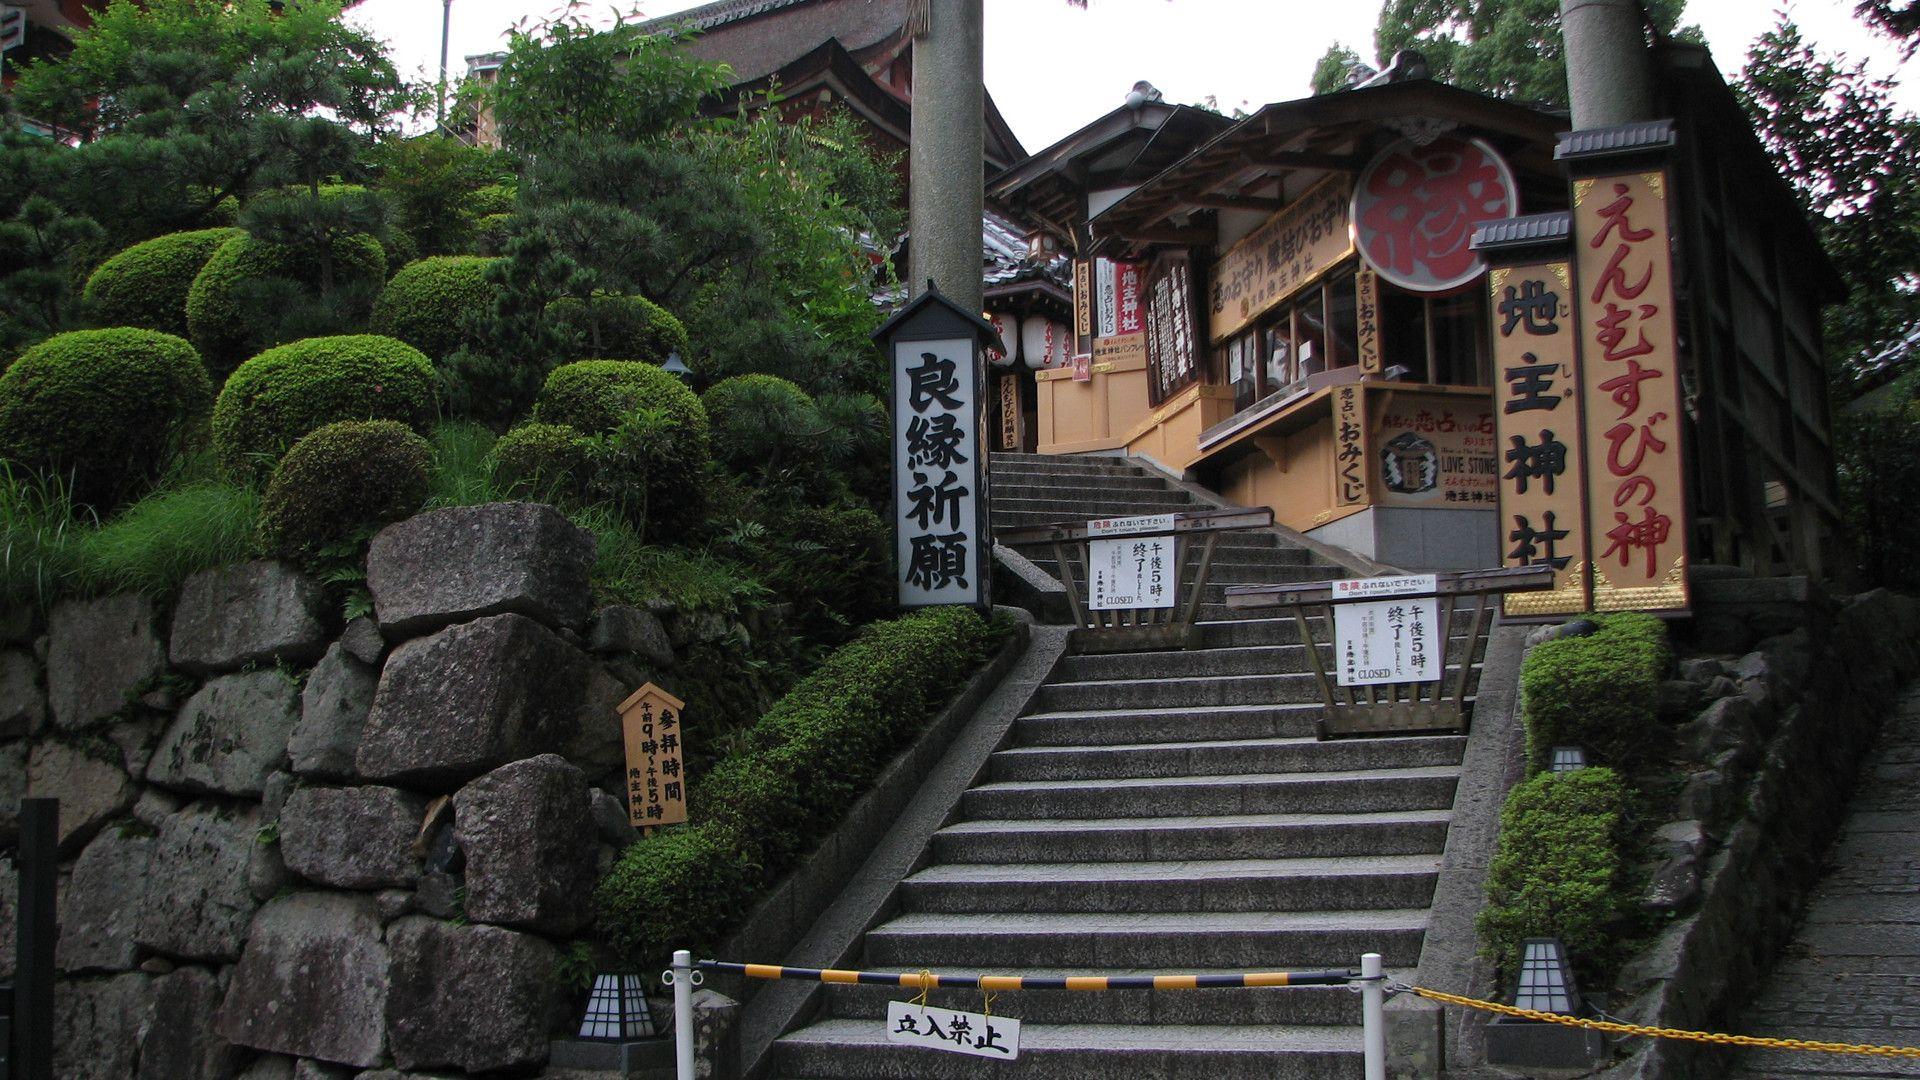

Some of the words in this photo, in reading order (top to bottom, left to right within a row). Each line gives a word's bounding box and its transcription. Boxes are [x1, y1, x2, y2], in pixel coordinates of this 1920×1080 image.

[1121, 270, 1140, 331] 地主神社
[1359, 273, 1377, 371] 恋占いおみくじ
[1590, 183, 1672, 578] えんむすびの神
[1338, 388, 1364, 502] 恋占いおみくじ
[1497, 279, 1574, 570] 地主神社
[905, 352, 969, 591] 良縁祈願
[1440, 456, 1464, 473] LOVE
[1468, 456, 1495, 474] STONE
[1106, 596, 1134, 605] CLOSED
[1358, 668, 1390, 680] CLOSED
[629, 767, 645, 821] 地主神社
[893, 1013, 1010, 1055] 立入禁止
